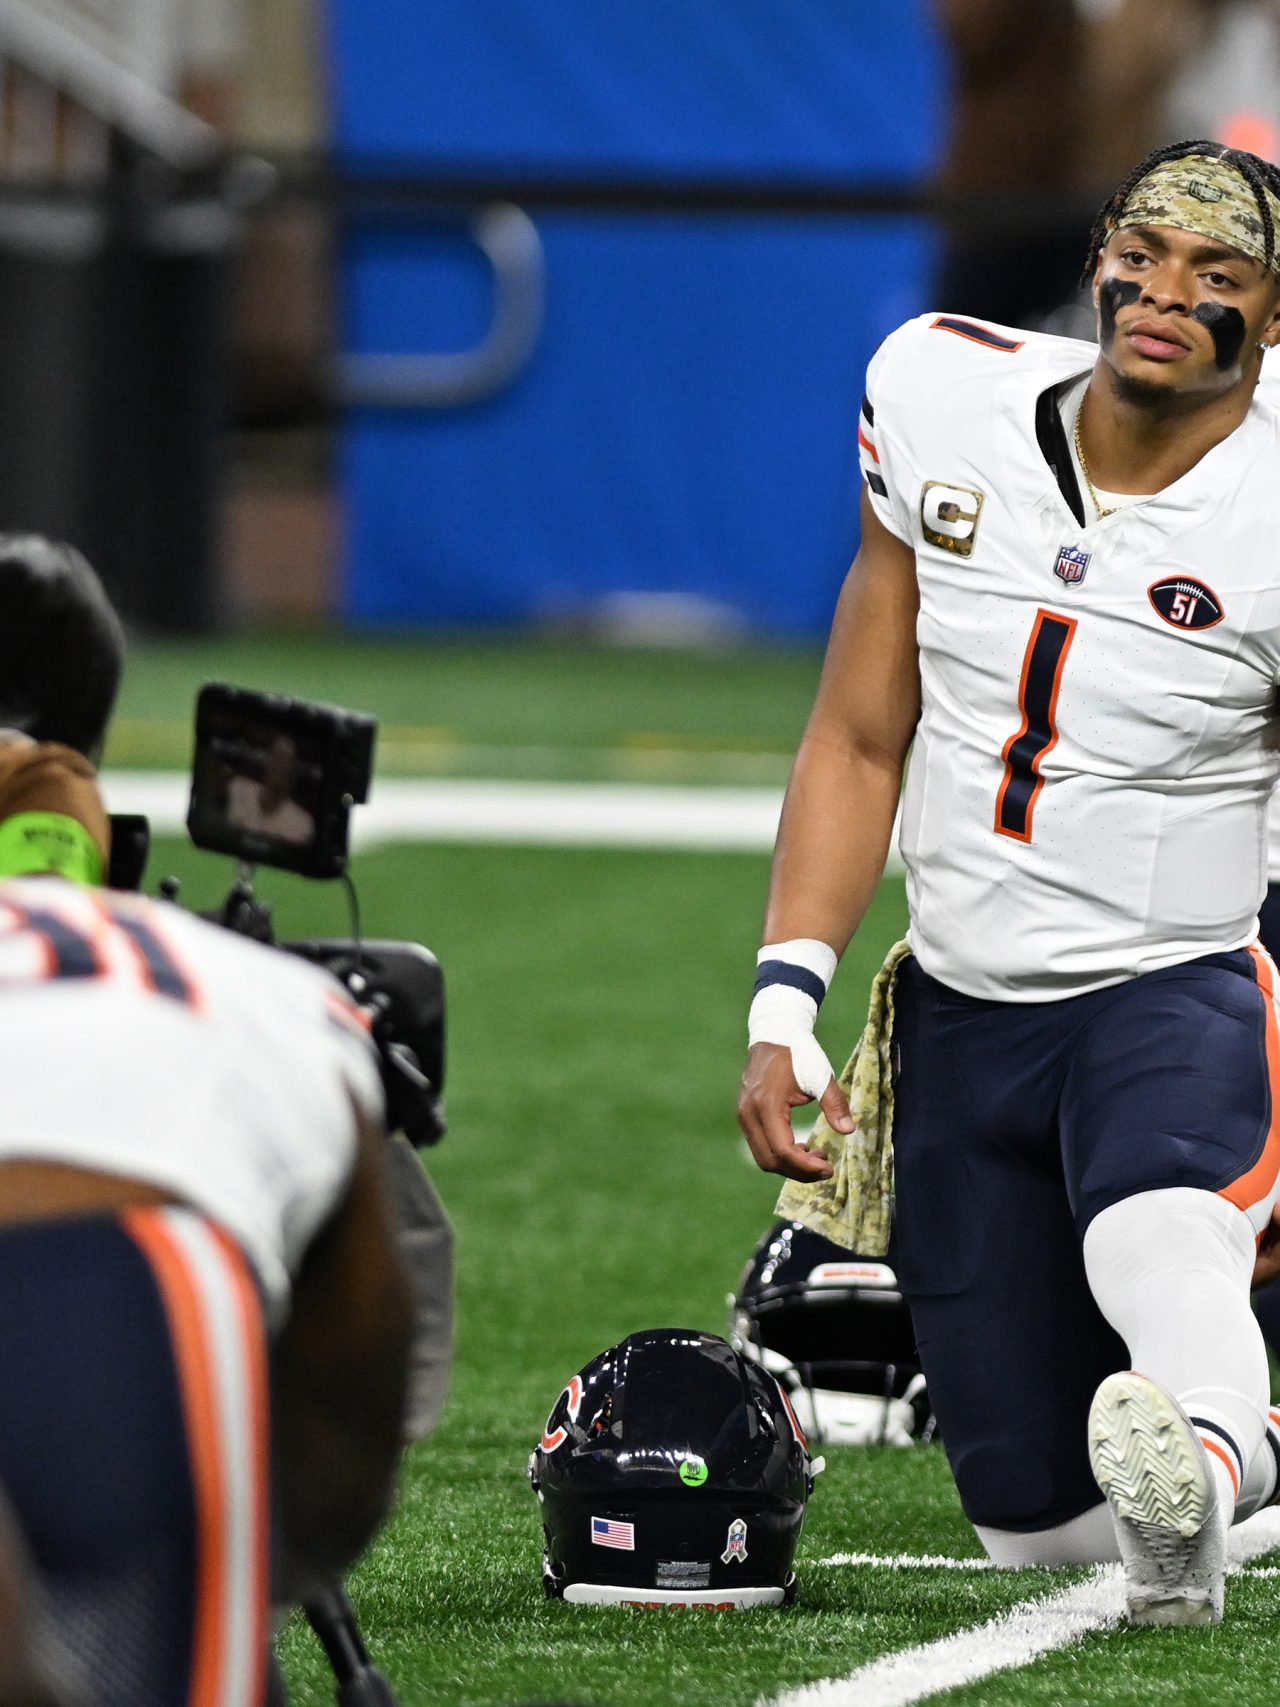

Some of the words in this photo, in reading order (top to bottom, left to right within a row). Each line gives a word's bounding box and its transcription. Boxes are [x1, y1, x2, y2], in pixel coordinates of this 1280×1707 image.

[1057, 559, 1081, 580] NFL
[1169, 591, 1198, 625] 51
[993, 608, 1078, 844] 1
